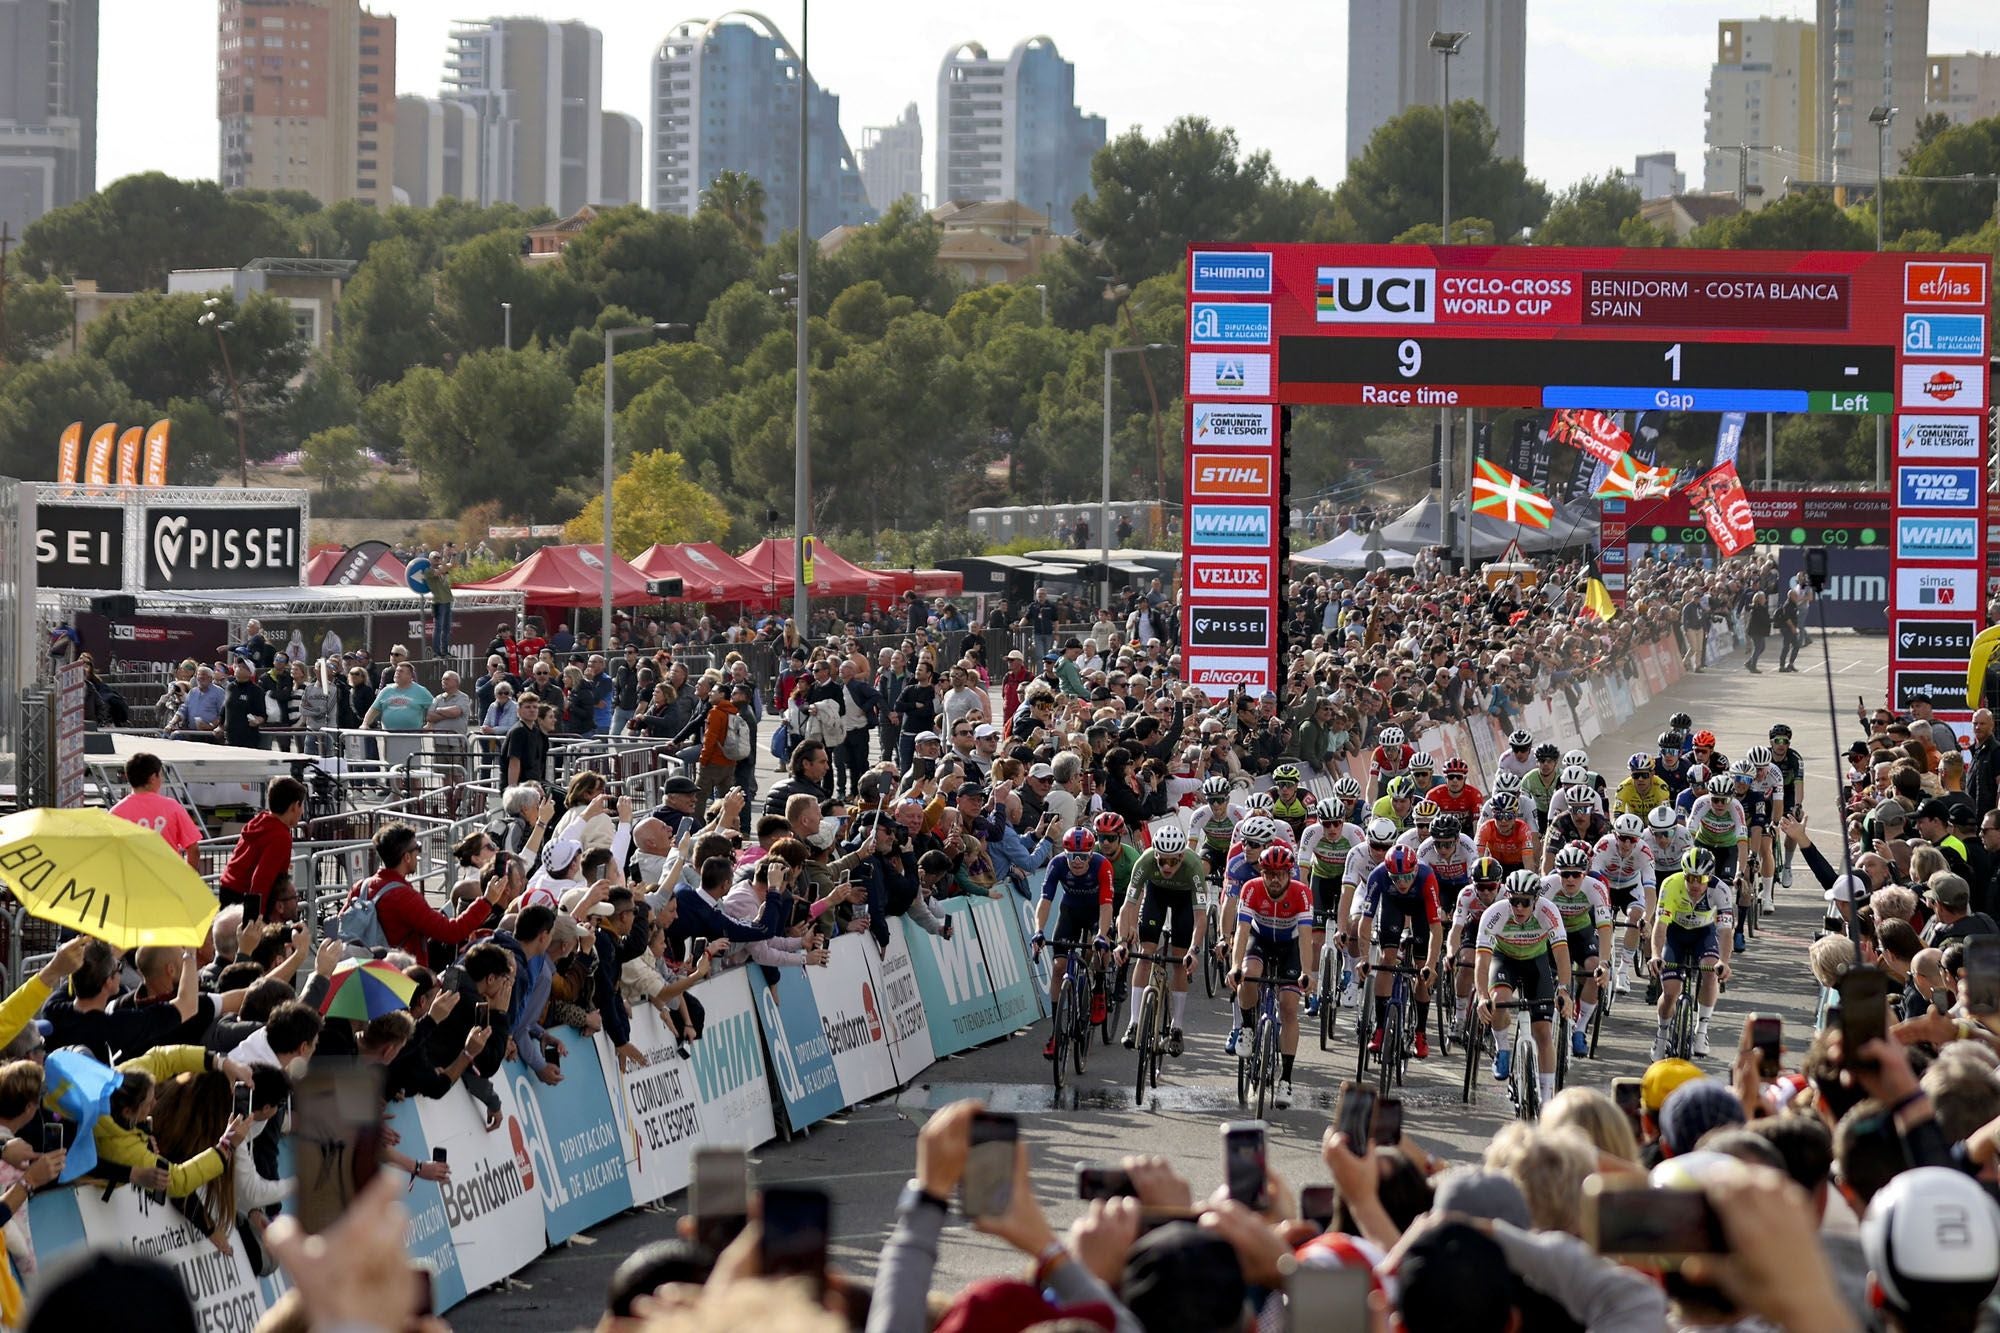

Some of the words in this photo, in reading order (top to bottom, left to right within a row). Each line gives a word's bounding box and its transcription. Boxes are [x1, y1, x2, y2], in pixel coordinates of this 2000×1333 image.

[1200, 267, 1265, 279] SHIMANO
[1443, 278, 1572, 296] CYCLO-CROSS
[1590, 281, 1688, 297] BENIDORM
[1706, 282, 1765, 299] COSTA
[1770, 283, 1839, 300] BLANCA
[1920, 267, 1970, 300] ethias
[1338, 278, 1426, 312] UCI
[1443, 299, 1510, 315] WORLD
[1515, 300, 1552, 316] CUP
[1590, 301, 1641, 317] SPAIN
[1225, 323, 1268, 332] DIPUTACIÓN
[1398, 339, 1422, 378] 9
[1664, 344, 1682, 382] 1
[1362, 385, 1411, 404] Race
[1416, 387, 1459, 405] time
[1655, 391, 1695, 410] Gap
[1831, 393, 1869, 412] Left
[1210, 418, 1262, 427] COMUNITAT
[1214, 427, 1226, 435] DE
[1228, 427, 1268, 436] L'ESPORT
[1917, 430, 1969, 438] COMUNITAT
[1921, 438, 1932, 446] DE
[1934, 438, 1975, 446] L'ESPORT
[91, 437, 109, 485] STIHL
[149, 433, 163, 485] STIHL
[1200, 467, 1263, 483] STIHL
[1907, 474, 1957, 487] TOYO
[1915, 488, 1969, 500] TIRES
[1195, 514, 1266, 532] WHIM
[1751, 510, 1771, 518] ORLD
[1681, 528, 1707, 543] GO
[1755, 529, 1780, 543] GO
[1822, 529, 1848, 544] GO
[1901, 527, 1973, 544] WHIM
[190, 527, 294, 570] PISSEI
[1198, 568, 1260, 584] VELUX
[1920, 574, 1955, 587] simac
[1212, 621, 1264, 632] PISSEI
[1918, 635, 1970, 647] PISSEI
[1487, 911, 1502, 930] crelan
[928, 900, 1020, 1006] WHIM
[822, 1010, 872, 1056] Benidorm
[690, 1010, 763, 1105] WHIM
[630, 1068, 685, 1115] COMUNITAT
[644, 1115, 663, 1150] DE
[659, 1102, 700, 1145] L'ESPORT
[559, 1119, 616, 1164] DIPUTACIÓN
[569, 1176, 584, 1200] DE
[583, 1156, 625, 1193] ALICANTE
[440, 1157, 523, 1229] Benidorm
